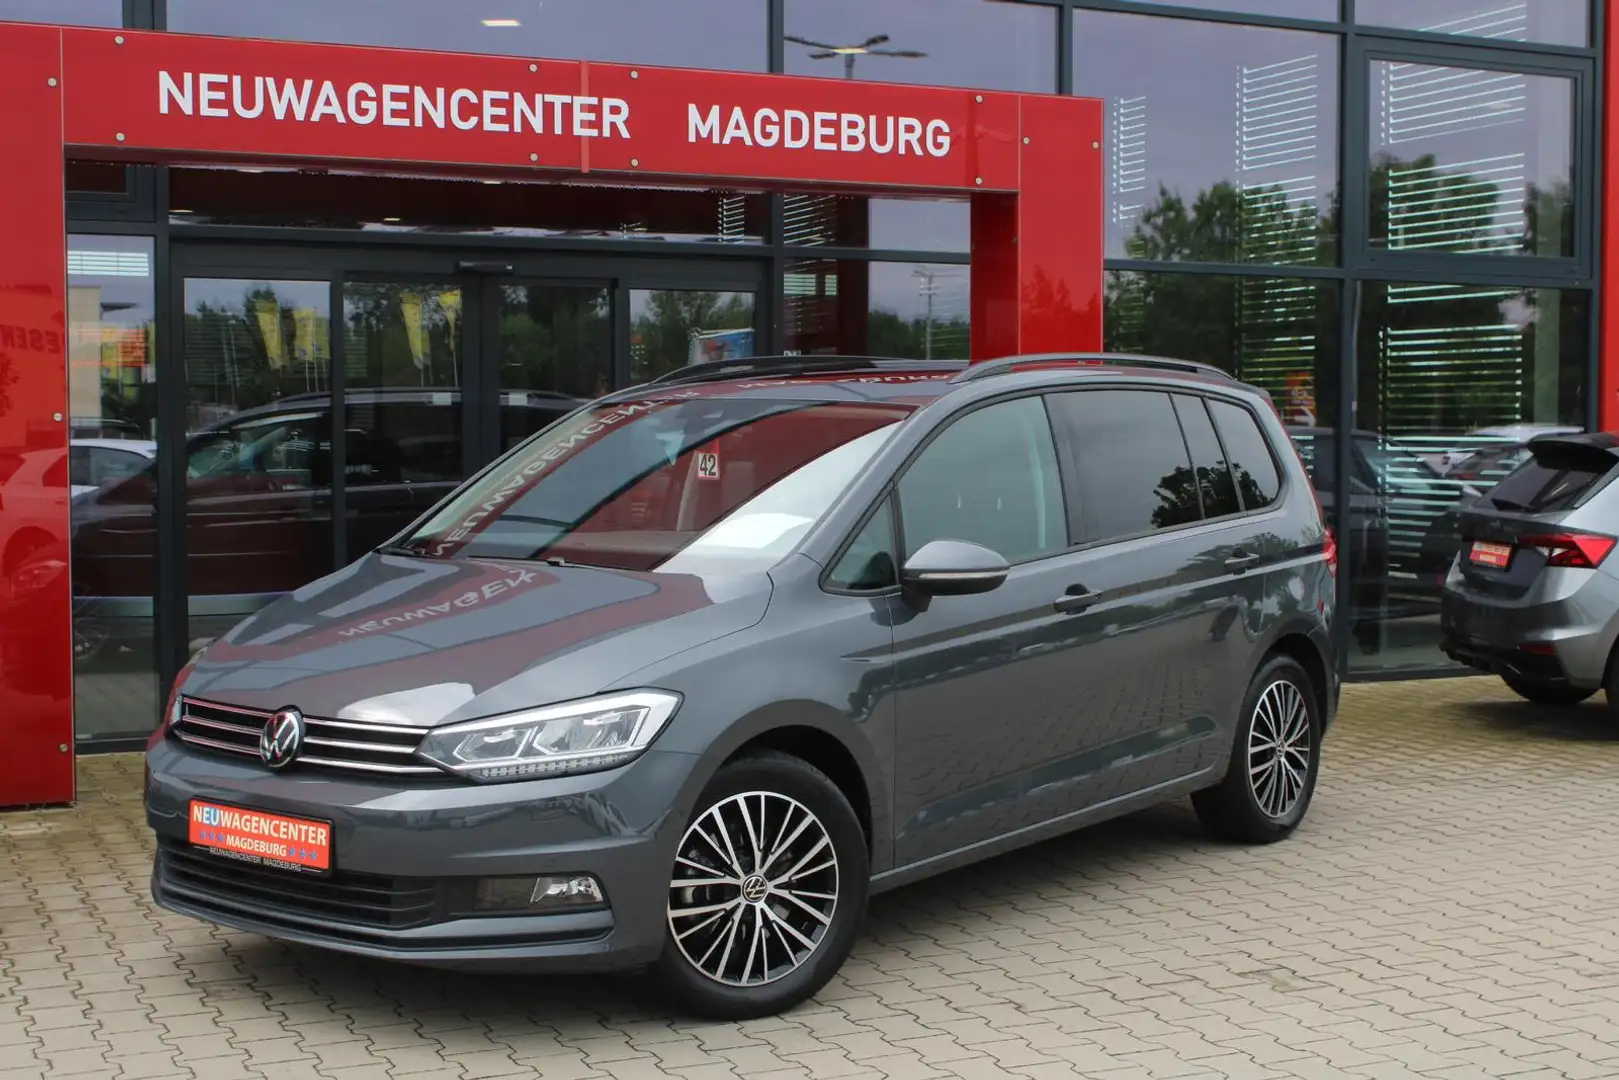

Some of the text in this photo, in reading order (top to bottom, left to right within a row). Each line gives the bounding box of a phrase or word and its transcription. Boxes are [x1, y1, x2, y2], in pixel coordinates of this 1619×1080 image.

[158, 70, 951, 157] NEUWAGENCENTER MAGDEBURG
[699, 454, 717, 476] 42
[193, 805, 327, 846] NEUWAGENCENTER
[226, 834, 287, 857] MAGDEBURG
